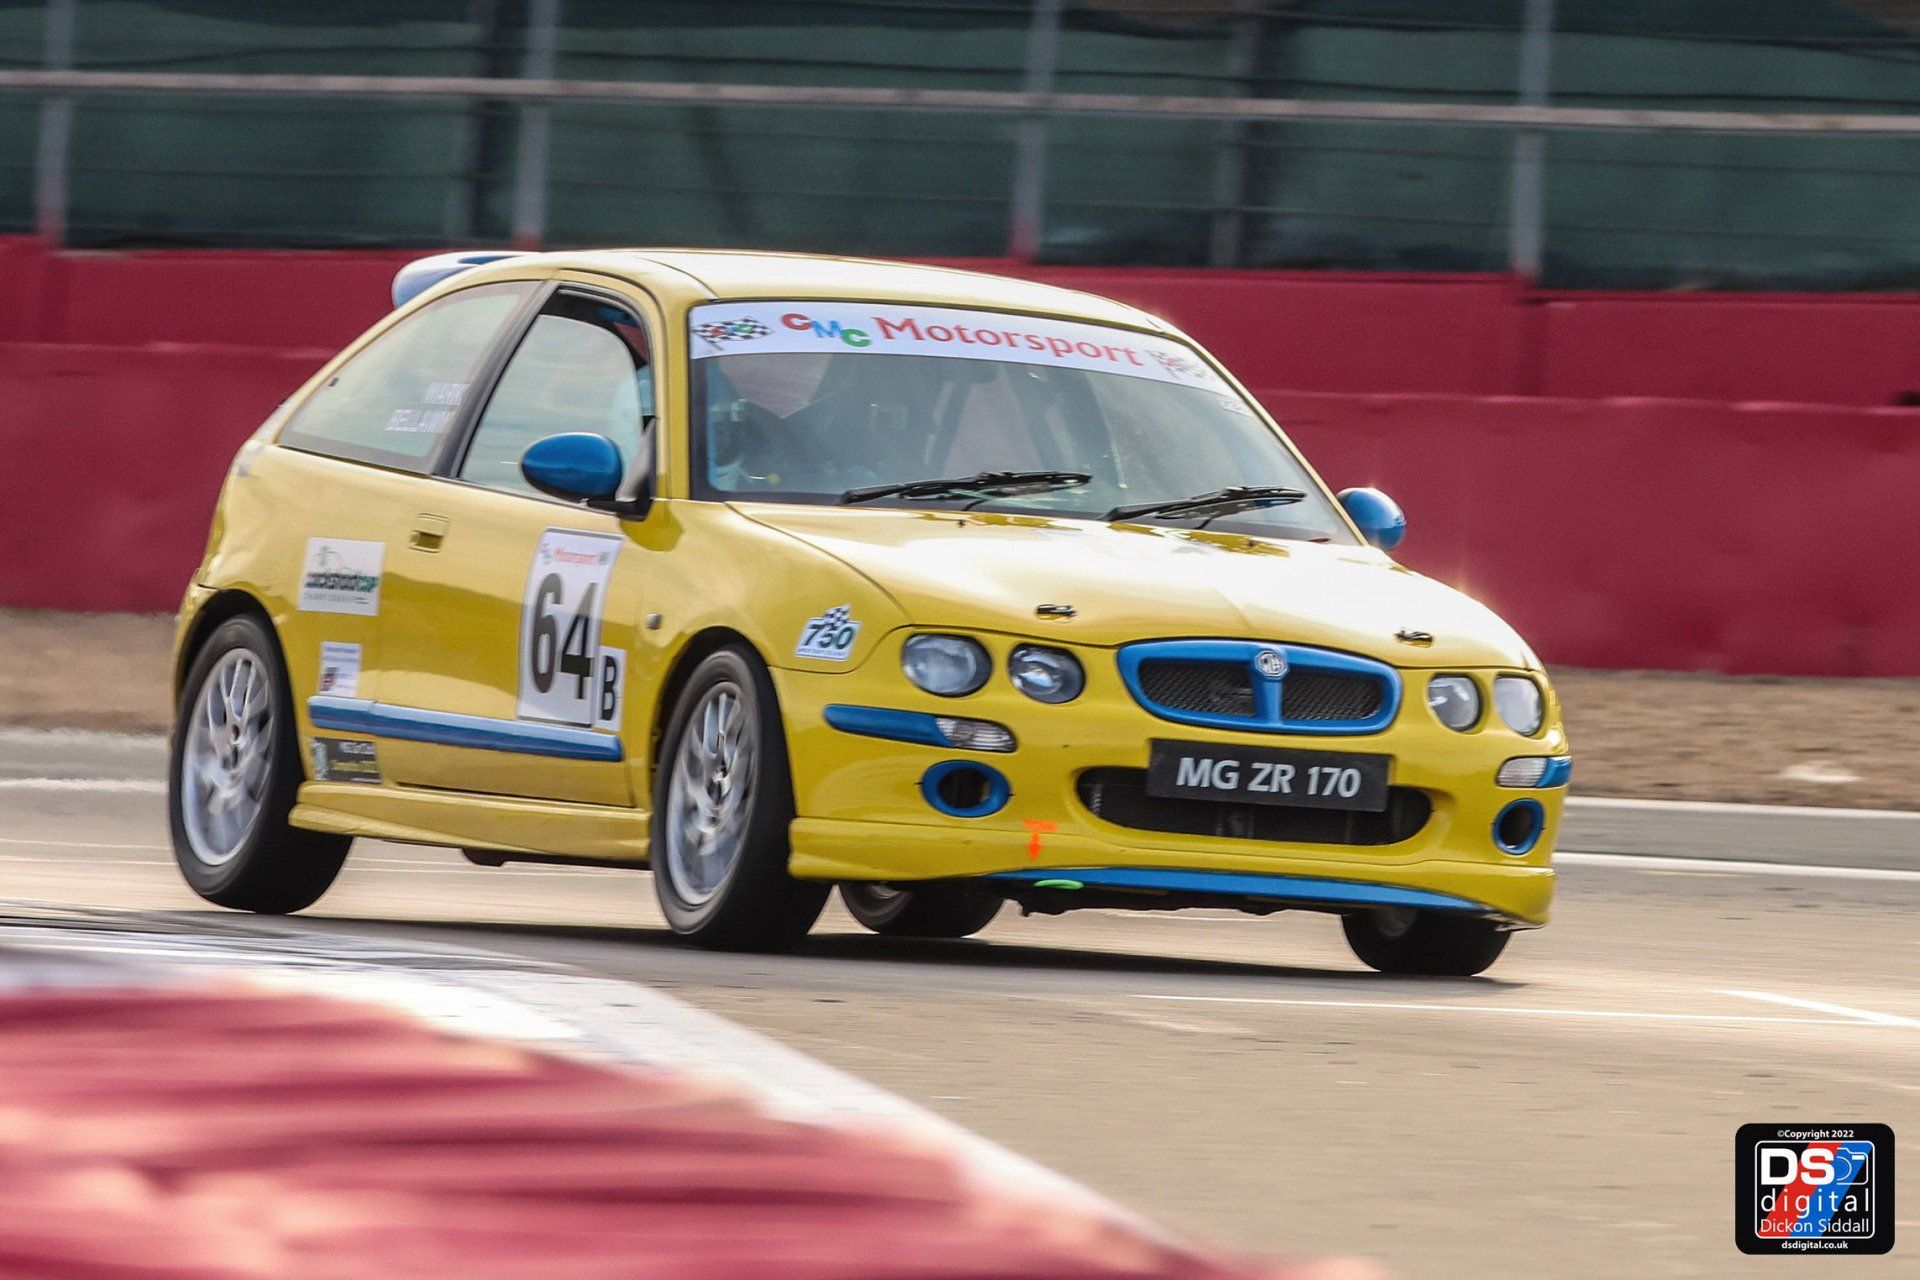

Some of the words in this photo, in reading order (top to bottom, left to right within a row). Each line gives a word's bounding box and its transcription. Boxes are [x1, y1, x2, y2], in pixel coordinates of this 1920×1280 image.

[781, 312, 871, 348] CMC
[870, 316, 1145, 367] Motorsport
[532, 573, 599, 700] 64
[802, 624, 854, 650] 750
[600, 655, 618, 721] B
[1175, 757, 1241, 790] MG
[1247, 762, 1296, 794] ZR
[1306, 766, 1362, 798] 170
